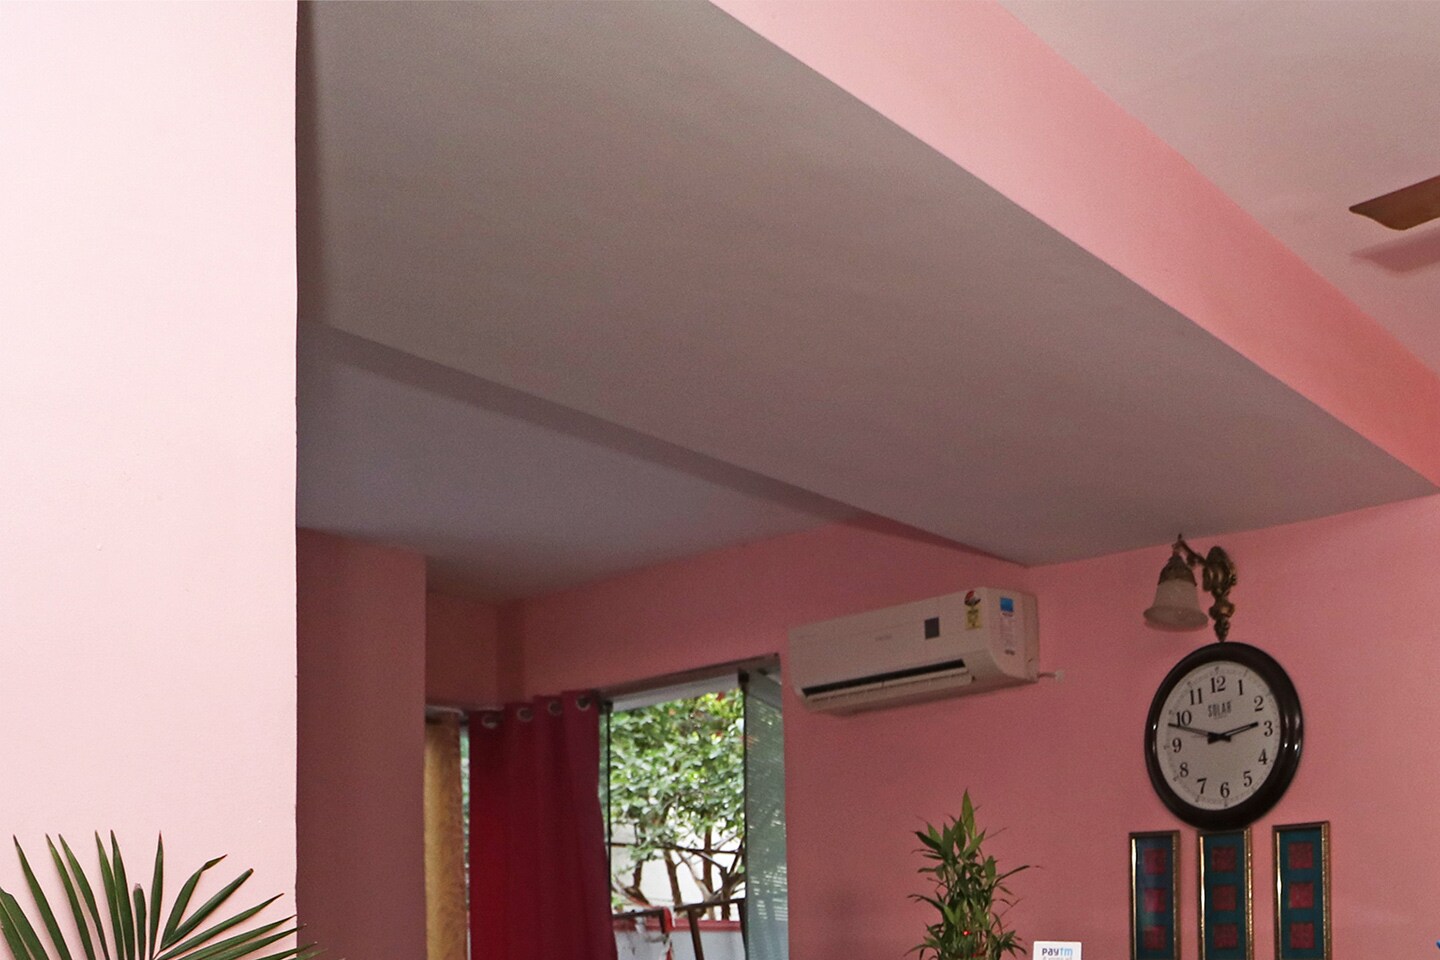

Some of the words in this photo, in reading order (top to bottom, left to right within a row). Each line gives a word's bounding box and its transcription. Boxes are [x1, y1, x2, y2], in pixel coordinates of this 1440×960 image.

[1210, 675, 1226, 693] 12
[1238, 679, 1244, 696] 1
[1190, 688, 1203, 705] 11
[1254, 695, 1264, 712] 2
[1175, 710, 1192, 727] 10
[1264, 721, 1273, 737] 3
[1172, 738, 1182, 753] 9
[1258, 749, 1268, 765] 4
[1179, 762, 1189, 778] 8
[1196, 778, 1207, 794] 7
[1243, 771, 1252, 787] 5
[1220, 782, 1230, 798] 6
